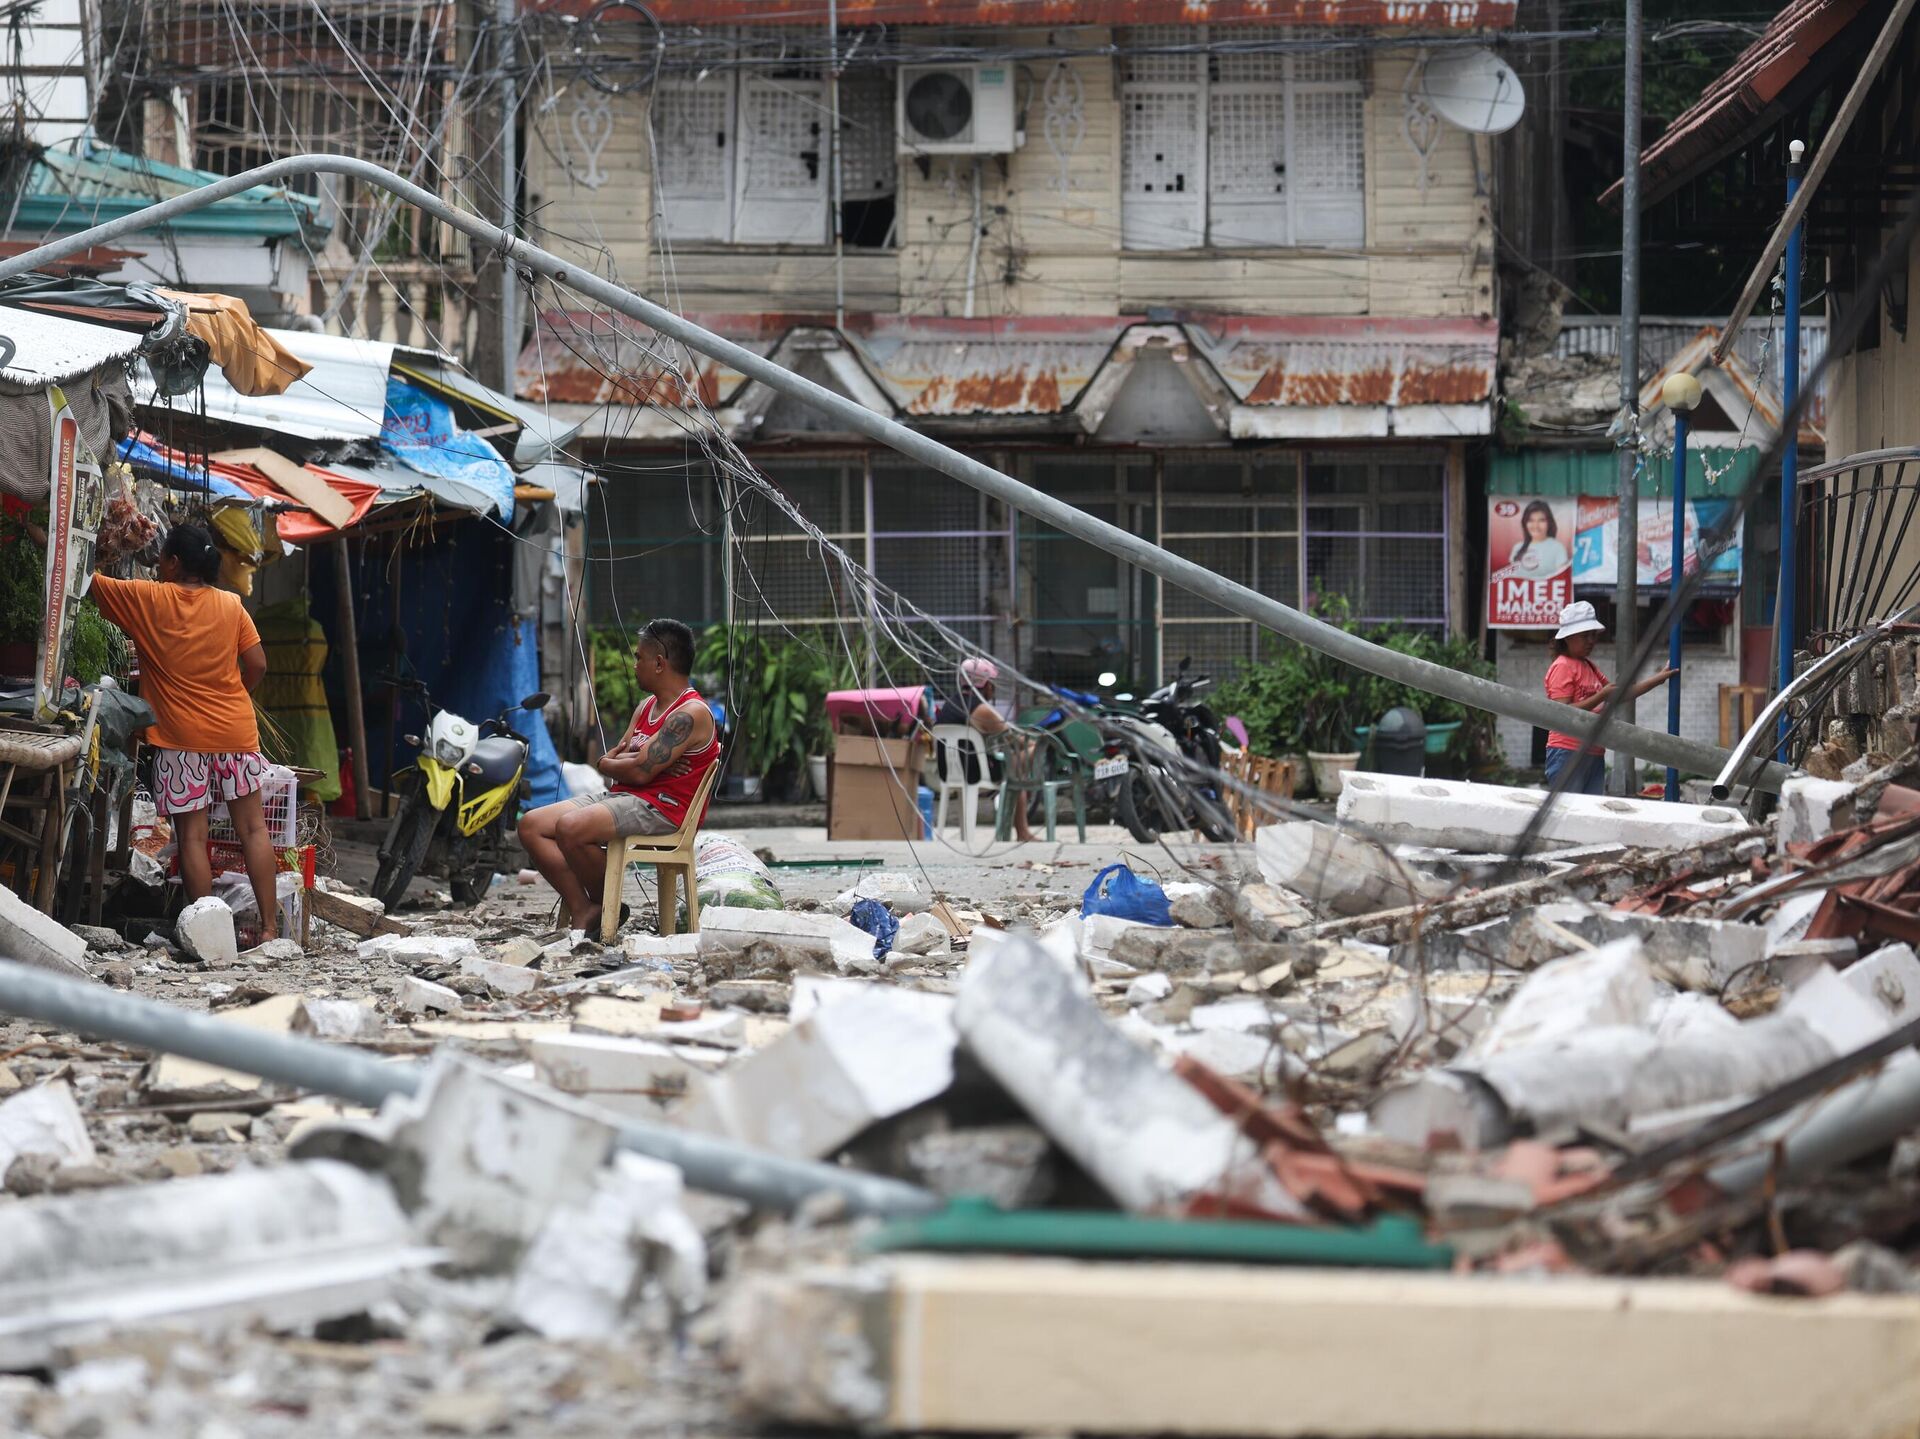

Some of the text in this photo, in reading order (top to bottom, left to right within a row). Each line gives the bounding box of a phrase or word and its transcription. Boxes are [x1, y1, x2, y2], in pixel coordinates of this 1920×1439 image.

[52, 548, 64, 606] PRODUCTS
[1497, 580, 1566, 602] IMEE
[1497, 601, 1564, 616] MARCOS
[1514, 614, 1561, 624] SENATO
[49, 608, 58, 638] FOOD
[45, 640, 55, 685] FROZEN
